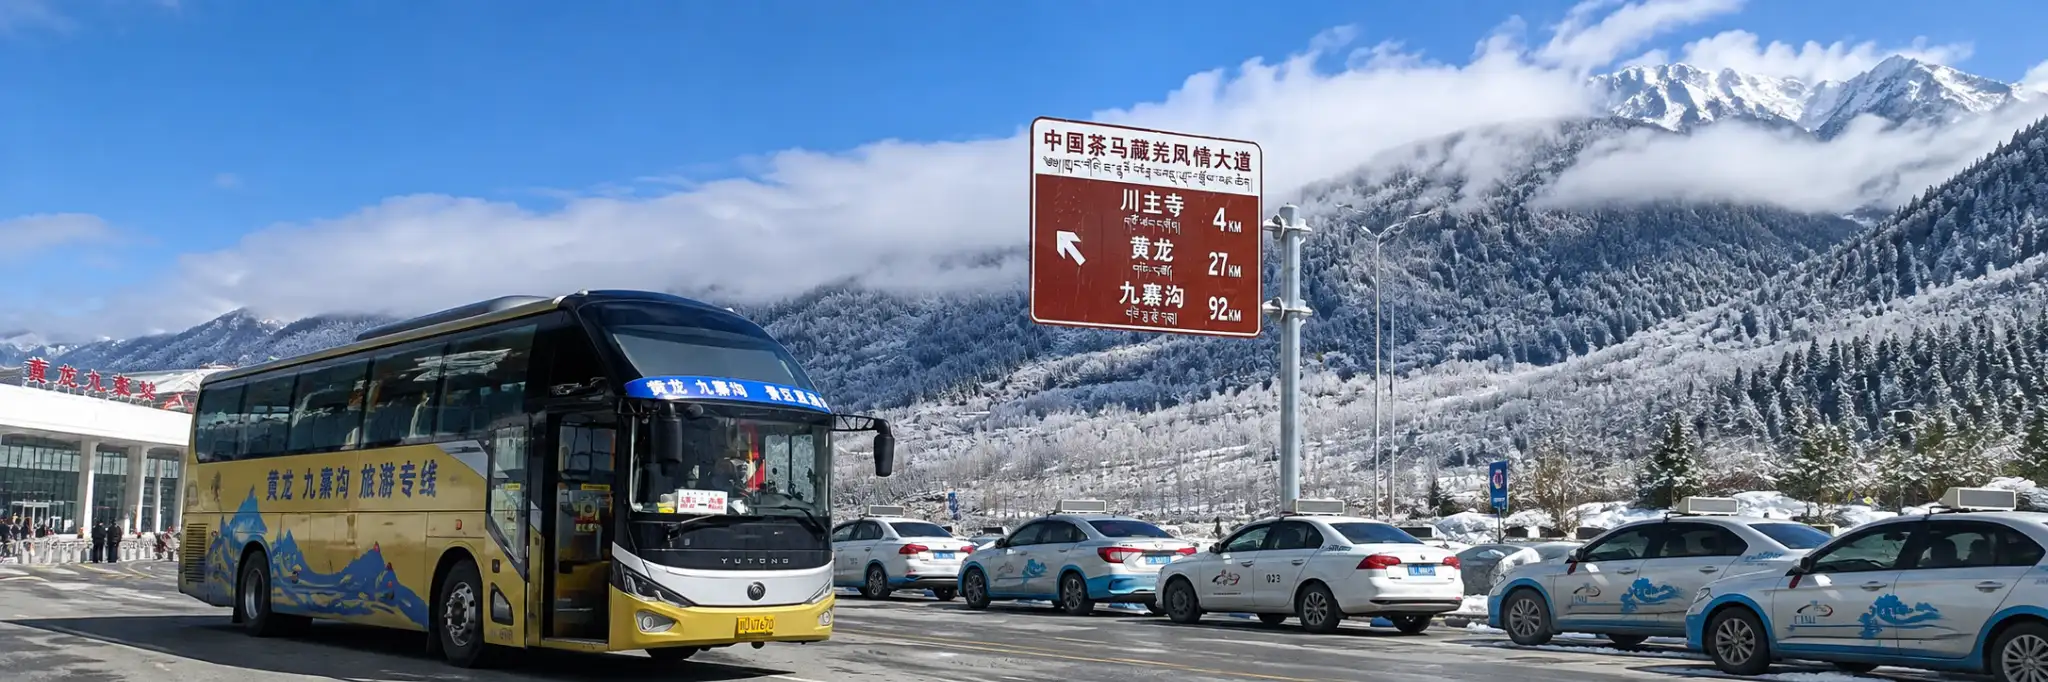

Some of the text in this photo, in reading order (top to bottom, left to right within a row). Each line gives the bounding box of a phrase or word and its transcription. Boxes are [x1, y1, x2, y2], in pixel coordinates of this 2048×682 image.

[1120, 188, 1185, 218] 川主寺
[1130, 235, 1174, 263] 黄龙
[1119, 280, 1185, 309] 九寨沟
[646, 379, 688, 396] 黄龙
[695, 379, 748, 398] 九寨沟
[266, 459, 438, 501] 黄龙 九寨沟 旅游专线
